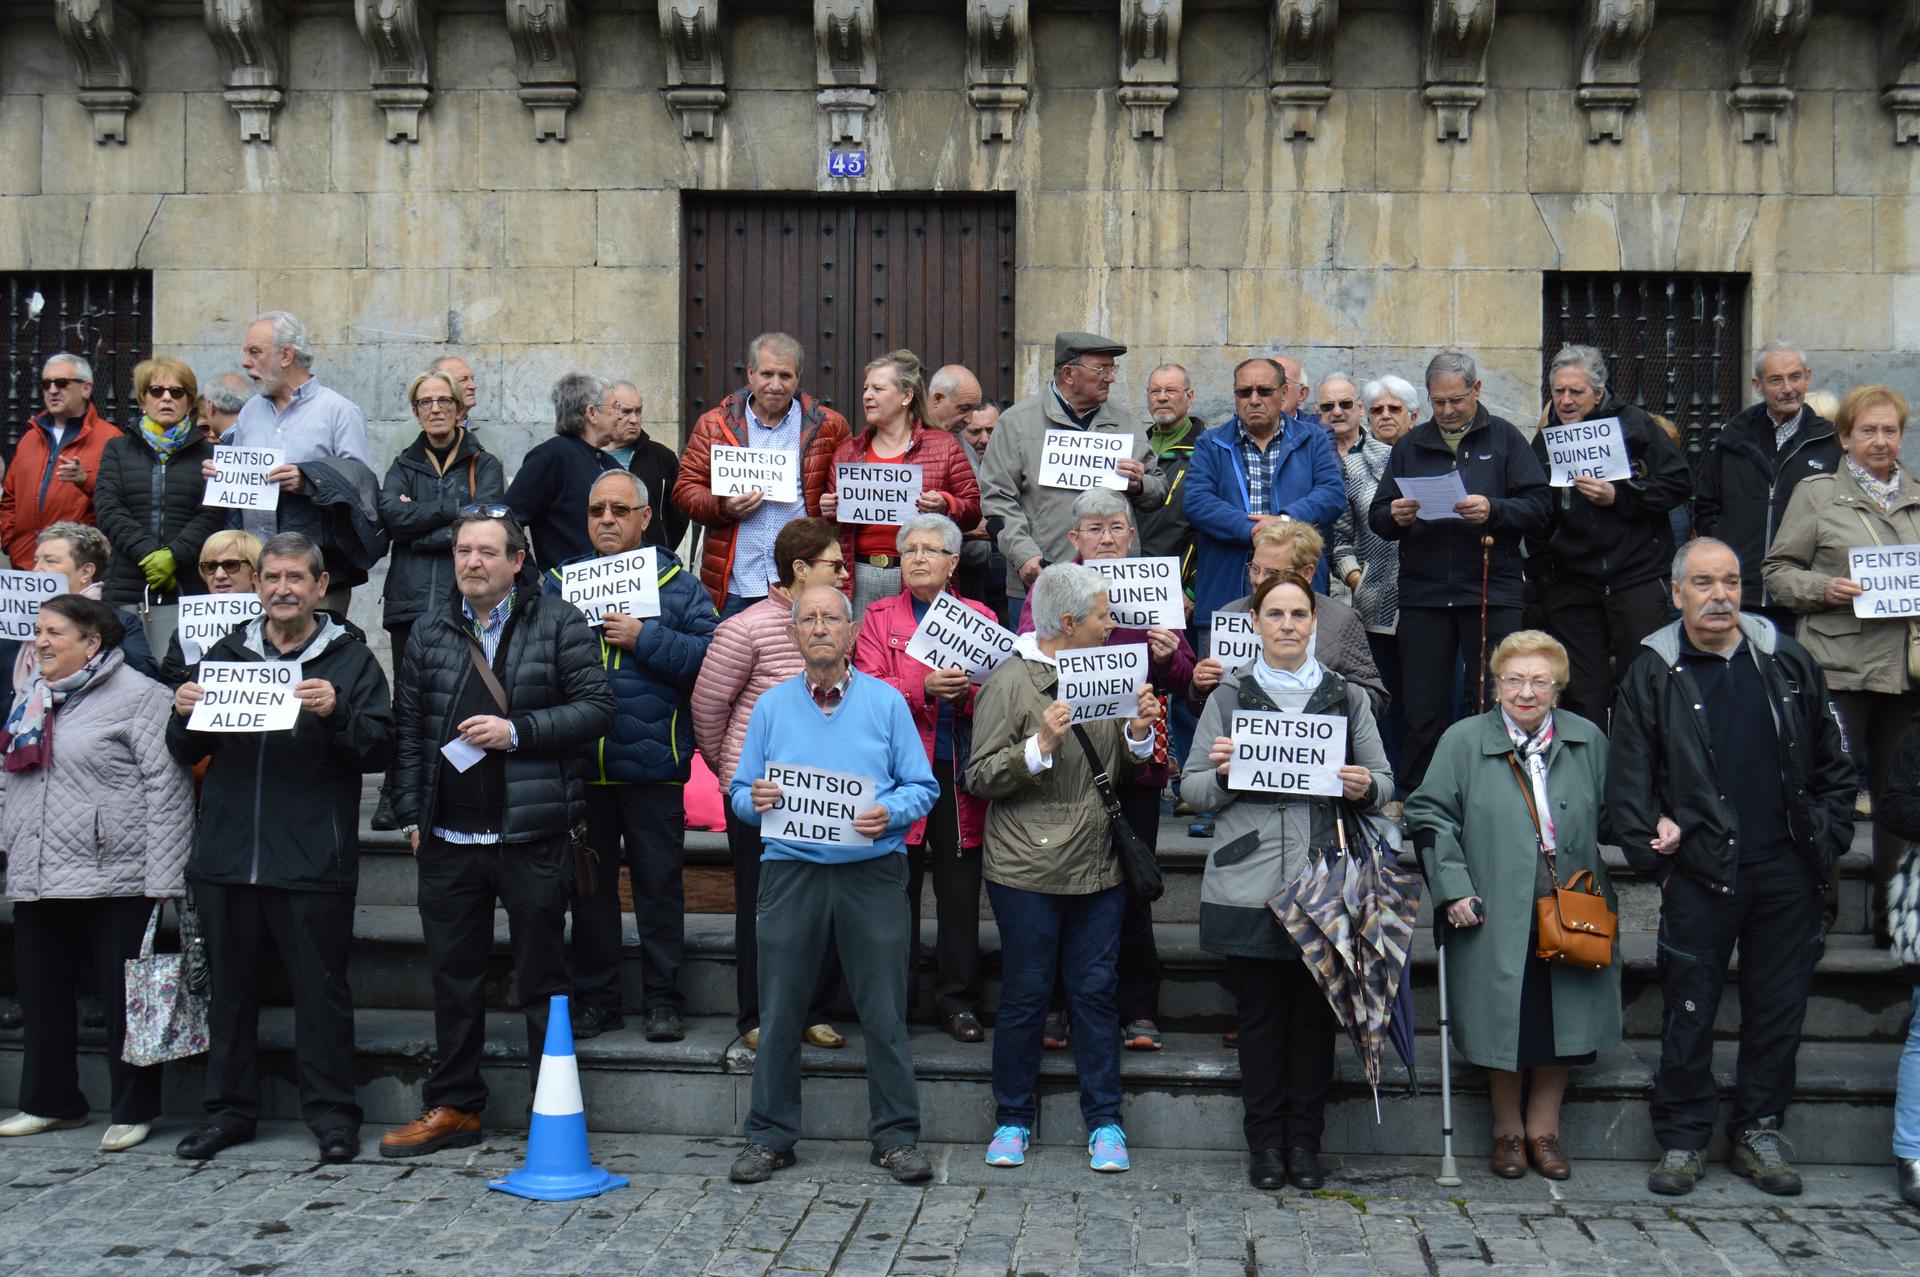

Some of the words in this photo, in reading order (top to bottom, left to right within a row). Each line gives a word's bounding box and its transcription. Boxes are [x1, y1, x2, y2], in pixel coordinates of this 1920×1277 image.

[832, 153, 862, 172] 43
[1047, 435, 1123, 450] PENTSIO
[1546, 424, 1611, 446] PENTSIO
[215, 451, 275, 466] PENTSIO
[714, 450, 787, 466] PENTSIO
[1048, 452, 1116, 470] DUINEN
[1554, 444, 1611, 464] DUINEN
[214, 471, 268, 486] DUINEN
[718, 466, 783, 481] DUINEN
[839, 467, 912, 483] PENTSIO
[1056, 472, 1103, 488] ALDE
[219, 491, 259, 505] ALDE
[843, 487, 908, 503] DUINEN
[852, 508, 897, 522] ALDE
[1852, 552, 1920, 569] PENTS
[566, 556, 645, 584] PENTSIO
[1, 575, 57, 593] NTSIO
[570, 578, 641, 604] DUINEN
[1860, 575, 1920, 591] DUINE
[1108, 586, 1168, 604] UINEN
[182, 600, 263, 617] PENTSIO
[585, 601, 631, 624] ALDE
[1874, 598, 1920, 614] ALDE
[934, 598, 1014, 652] PENTSIO
[1110, 611, 1160, 625] ALDE
[0, 622, 36, 636] ALD
[185, 623, 238, 639] DUIN
[926, 621, 998, 670] DUINEN
[1059, 652, 1137, 674] PENTSIO
[202, 668, 291, 684] PENTSIO
[1066, 678, 1134, 699] DUINEN
[204, 690, 285, 706] DUINEN
[210, 712, 266, 728] ALDE
[1072, 702, 1119, 721] ALDE
[1235, 717, 1333, 739] PENTSIO
[1239, 744, 1326, 765] DUINEN
[769, 768, 862, 796] PENTSIO
[1251, 770, 1310, 790] ALDE
[772, 795, 855, 820] DUINEN
[783, 821, 841, 842] ALDE
